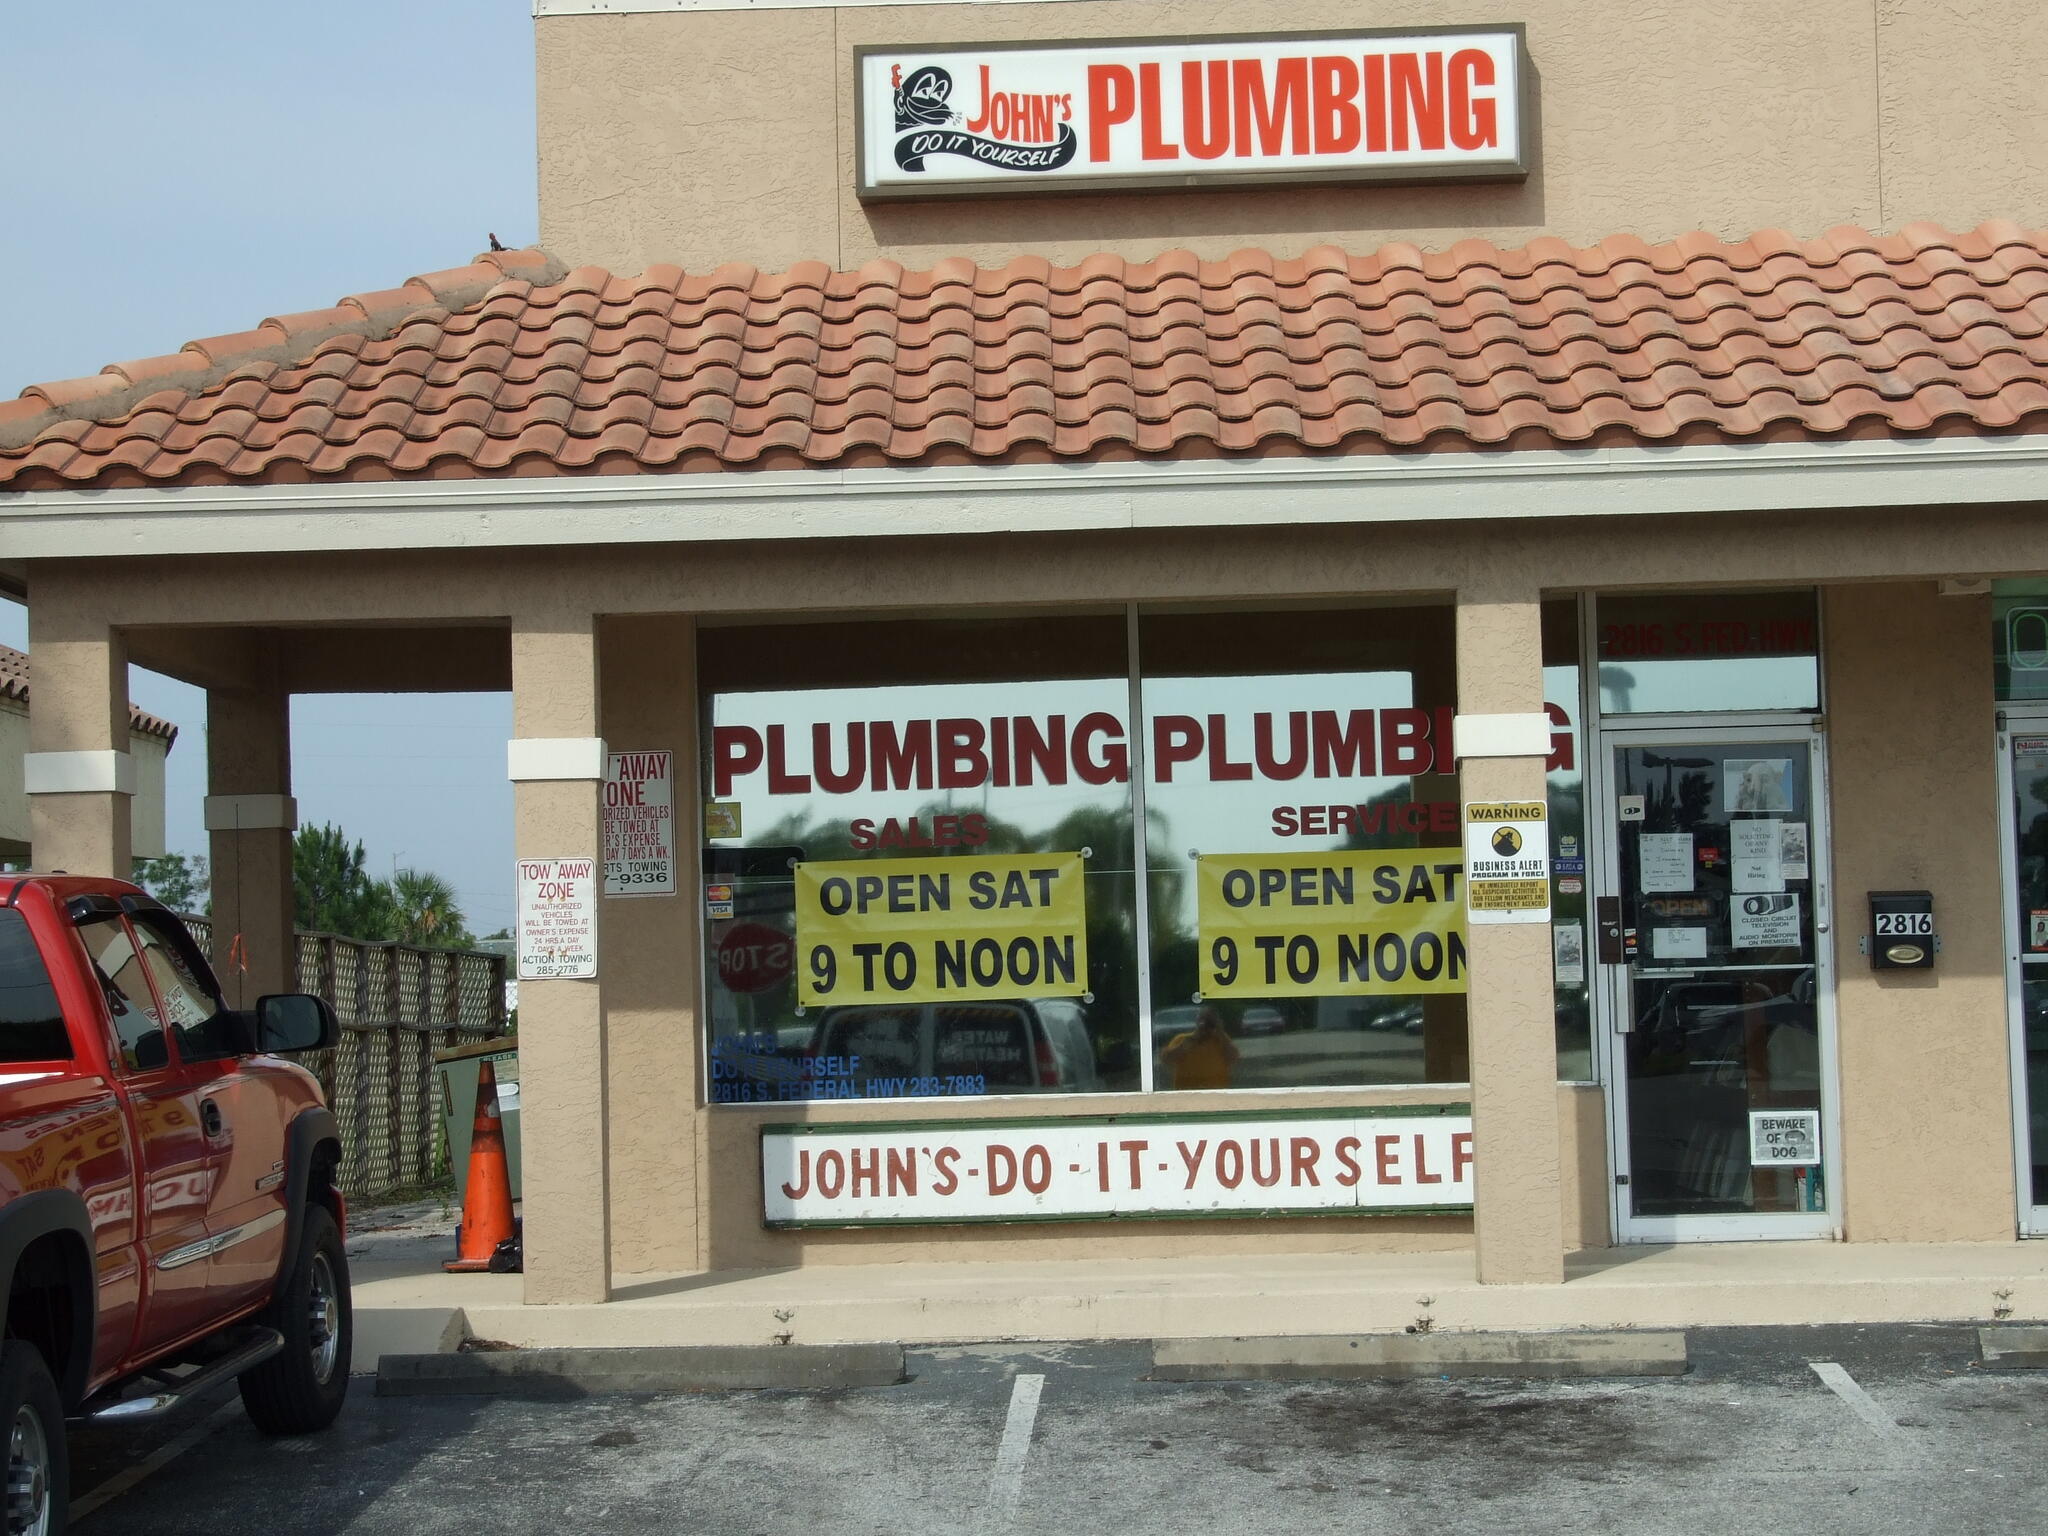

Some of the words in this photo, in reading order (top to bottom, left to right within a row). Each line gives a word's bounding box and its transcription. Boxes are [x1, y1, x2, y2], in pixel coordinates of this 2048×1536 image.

[966, 64, 1072, 143] JOHN'S
[1087, 47, 1498, 163] PLUMBING
[911, 133, 943, 154] DO
[946, 135, 968, 150] IT
[971, 138, 1062, 167] YOURSELF
[1603, 623, 1664, 657] 2816
[713, 711, 1129, 797] PLUMBING
[619, 754, 667, 781] AWAY
[603, 780, 646, 807] ONE
[633, 805, 669, 819] VEHICLES
[1271, 800, 1458, 837] SERVICE
[1470, 807, 1541, 819] WARNING
[605, 820, 615, 834] BE
[618, 819, 647, 834] TOWED
[650, 819, 660, 833] AT
[849, 813, 990, 851] SALES
[623, 832, 661, 847] EXPENSE
[628, 846, 646, 861] DAYS
[649, 846, 654, 860] A
[521, 864, 551, 881] TOW
[557, 863, 591, 879] AWAY
[628, 860, 668, 873] TOWING
[1473, 860, 1516, 872] BUSINESS
[1518, 859, 1543, 871] ALERT
[1471, 871, 1509, 879] PROGRAM
[1521, 870, 1545, 878] FORCE
[538, 882, 575, 899] ZONE
[819, 872, 951, 916] OPEN
[969, 868, 1060, 910] SAT
[1222, 867, 1354, 909] OPEN
[1373, 864, 1463, 904] SAT
[1512, 887, 1537, 895] ACTIVITIES
[531, 903, 582, 911] UNAUTHORIZED
[541, 911, 573, 919] VEHICLES
[559, 927, 589, 935] EXPENSE
[1751, 921, 1789, 929] TELEVISION
[1878, 914, 1931, 934] 2816
[565, 944, 584, 952] WEEK
[522, 955, 555, 964] ACTION
[558, 954, 593, 964] TOWING
[810, 944, 837, 994] 9
[853, 941, 917, 992] TO
[935, 935, 1076, 989] NOON
[1211, 936, 1238, 986] 9
[1255, 933, 1319, 984] TO
[537, 965, 579, 975] 285-2776
[482, 1053, 512, 1062] PLEASE
[712, 1081, 751, 1102] 2816
[778, 1079, 861, 1100] FEDERAL
[866, 1077, 906, 1099] HWY
[910, 1074, 985, 1097] 283-7883
[1761, 1118, 1806, 1130] BEWARE
[1766, 1133, 1781, 1144] OF
[1772, 1146, 1798, 1158] DOG
